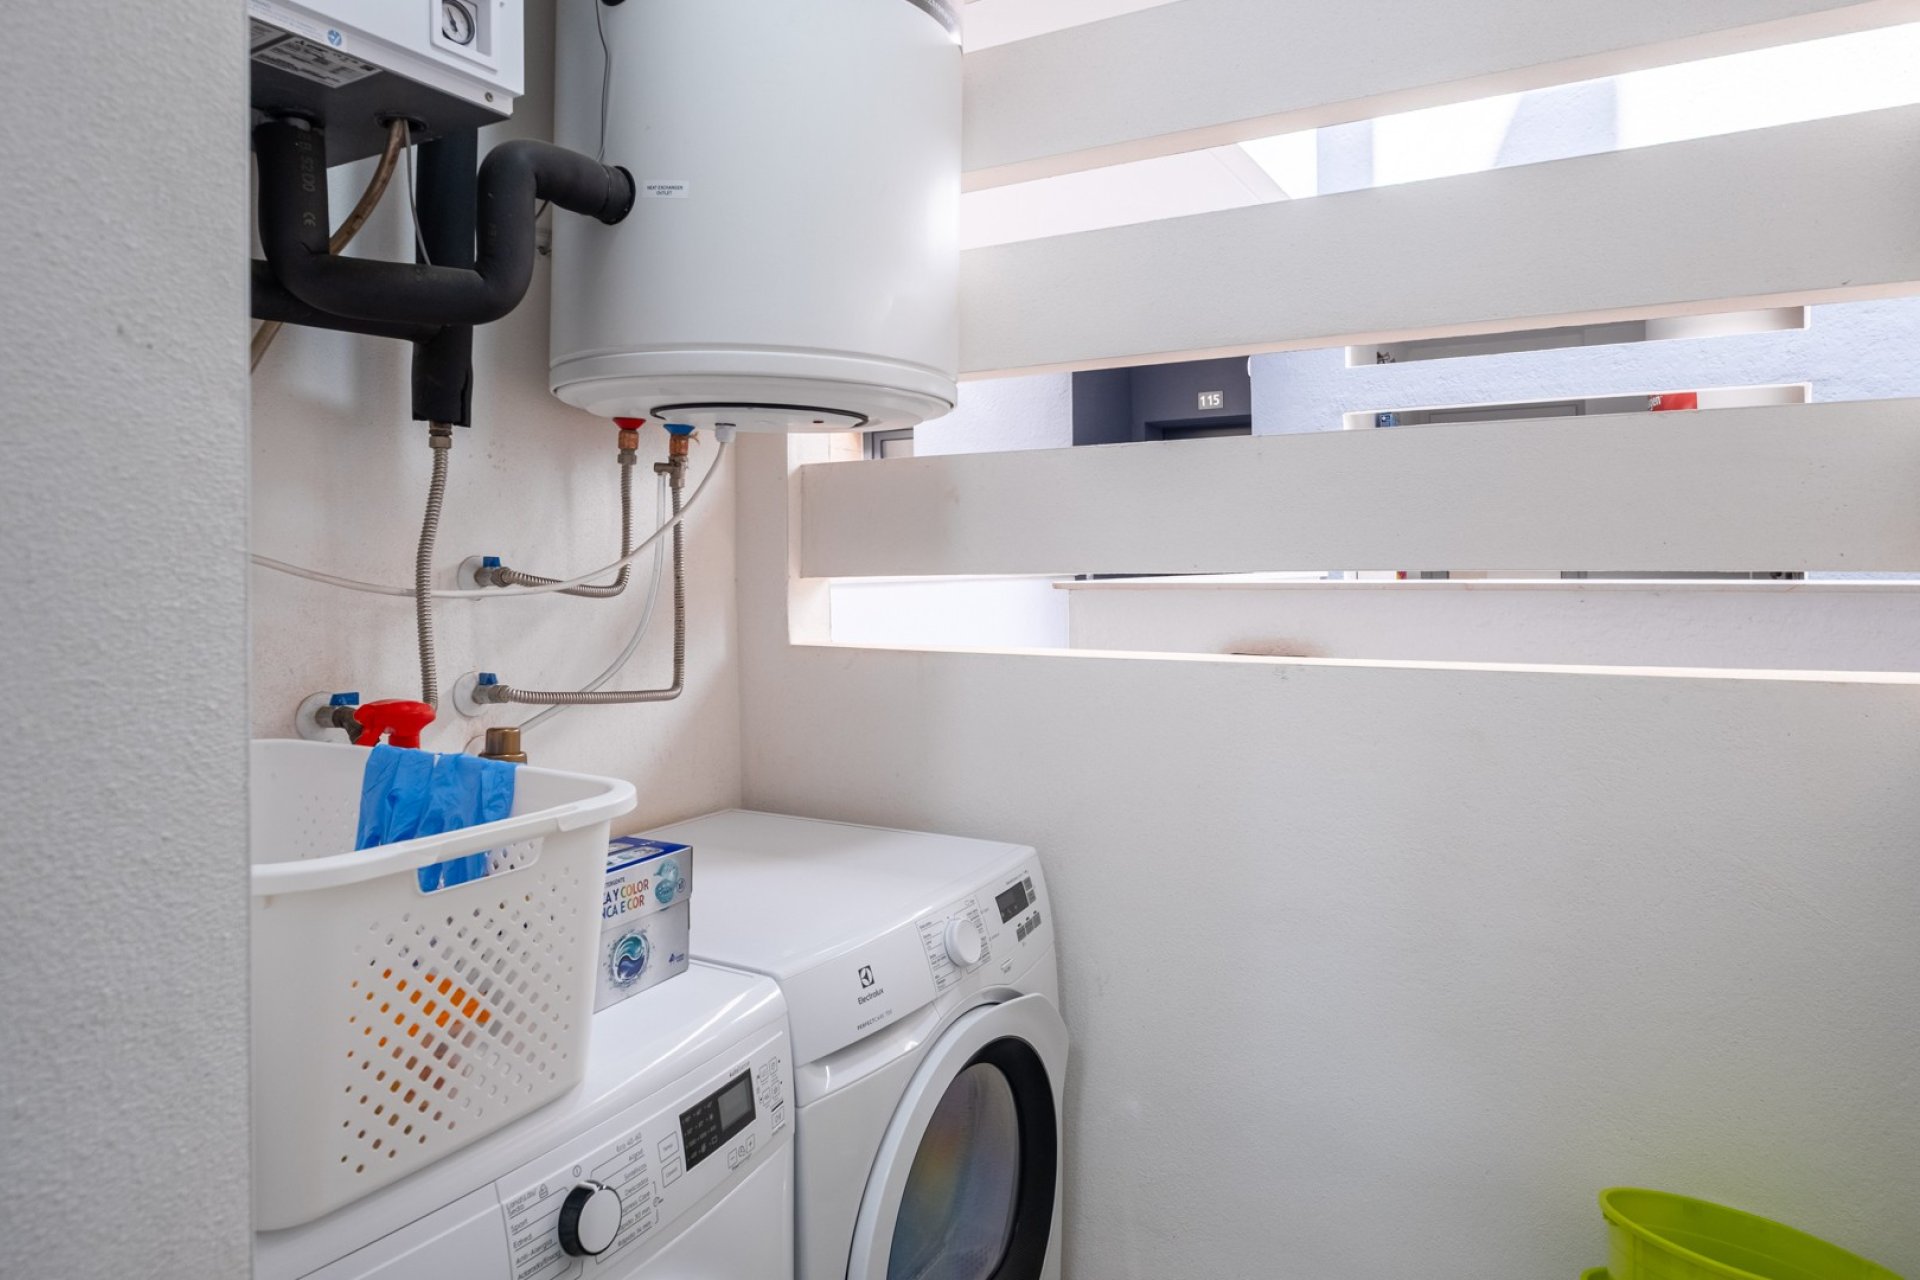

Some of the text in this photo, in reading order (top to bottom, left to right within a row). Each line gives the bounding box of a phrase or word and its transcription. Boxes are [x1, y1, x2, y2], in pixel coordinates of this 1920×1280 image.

[1200, 393, 1220, 408] 115
[612, 888, 619, 901] Y
[620, 878, 649, 899] COLOR
[620, 901, 626, 914] E
[627, 894, 645, 911] COR
[857, 987, 885, 1006] Electrolux
[511, 1218, 528, 1232] Sport
